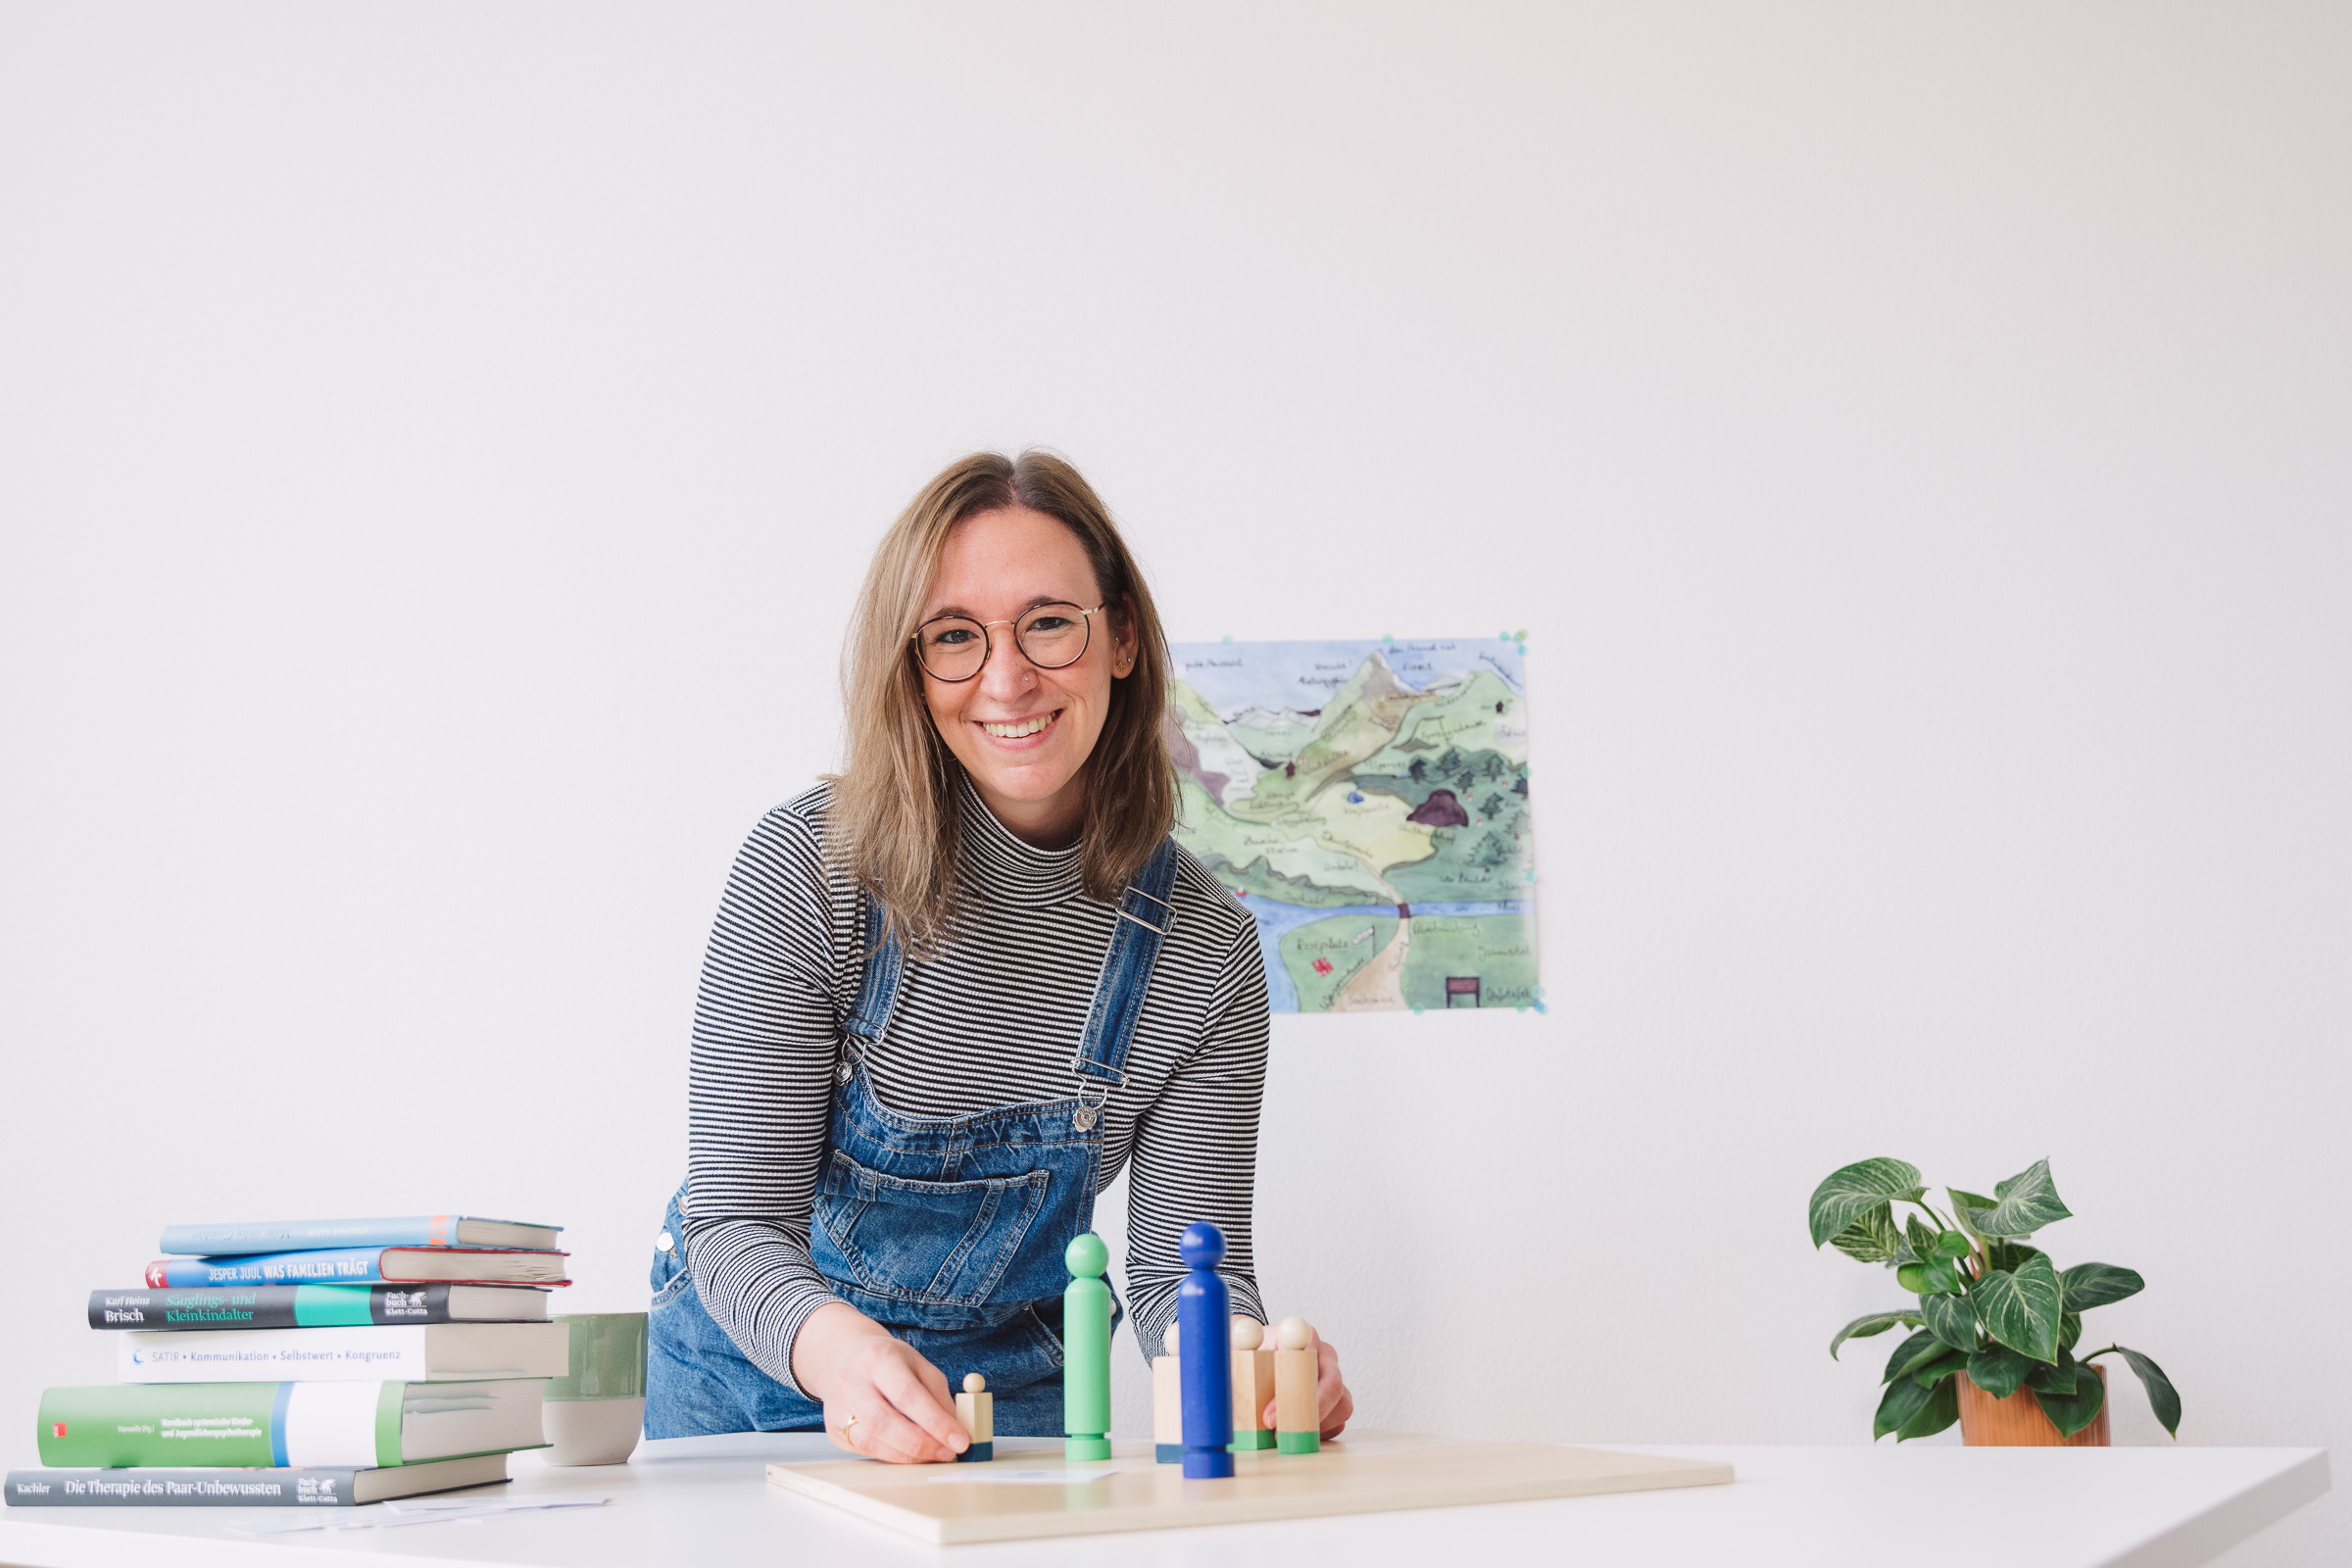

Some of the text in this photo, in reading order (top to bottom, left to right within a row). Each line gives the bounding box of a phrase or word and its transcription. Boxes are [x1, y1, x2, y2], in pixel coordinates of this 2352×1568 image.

[208, 1258, 369, 1282] JESPER JUUL WAS FAMILIEN TRÄGT
[386, 1291, 410, 1299] Fach-
[105, 1296, 151, 1307] Karl Heinz
[166, 1293, 257, 1309] Säuglings- und
[386, 1298, 408, 1306] buch
[105, 1307, 145, 1323] Brisch
[166, 1308, 255, 1323] Kleinkindalter
[385, 1307, 429, 1316] Klett-Cotta
[152, 1348, 402, 1363] SATIR Kommunikation Selbstwert Kongruenz
[18, 1479, 282, 1498] Kachler Die Therapie des Paar-Unbewussten
[298, 1478, 319, 1488] Fach-
[298, 1485, 318, 1494] buch
[298, 1494, 339, 1504] Klett-Cotta
